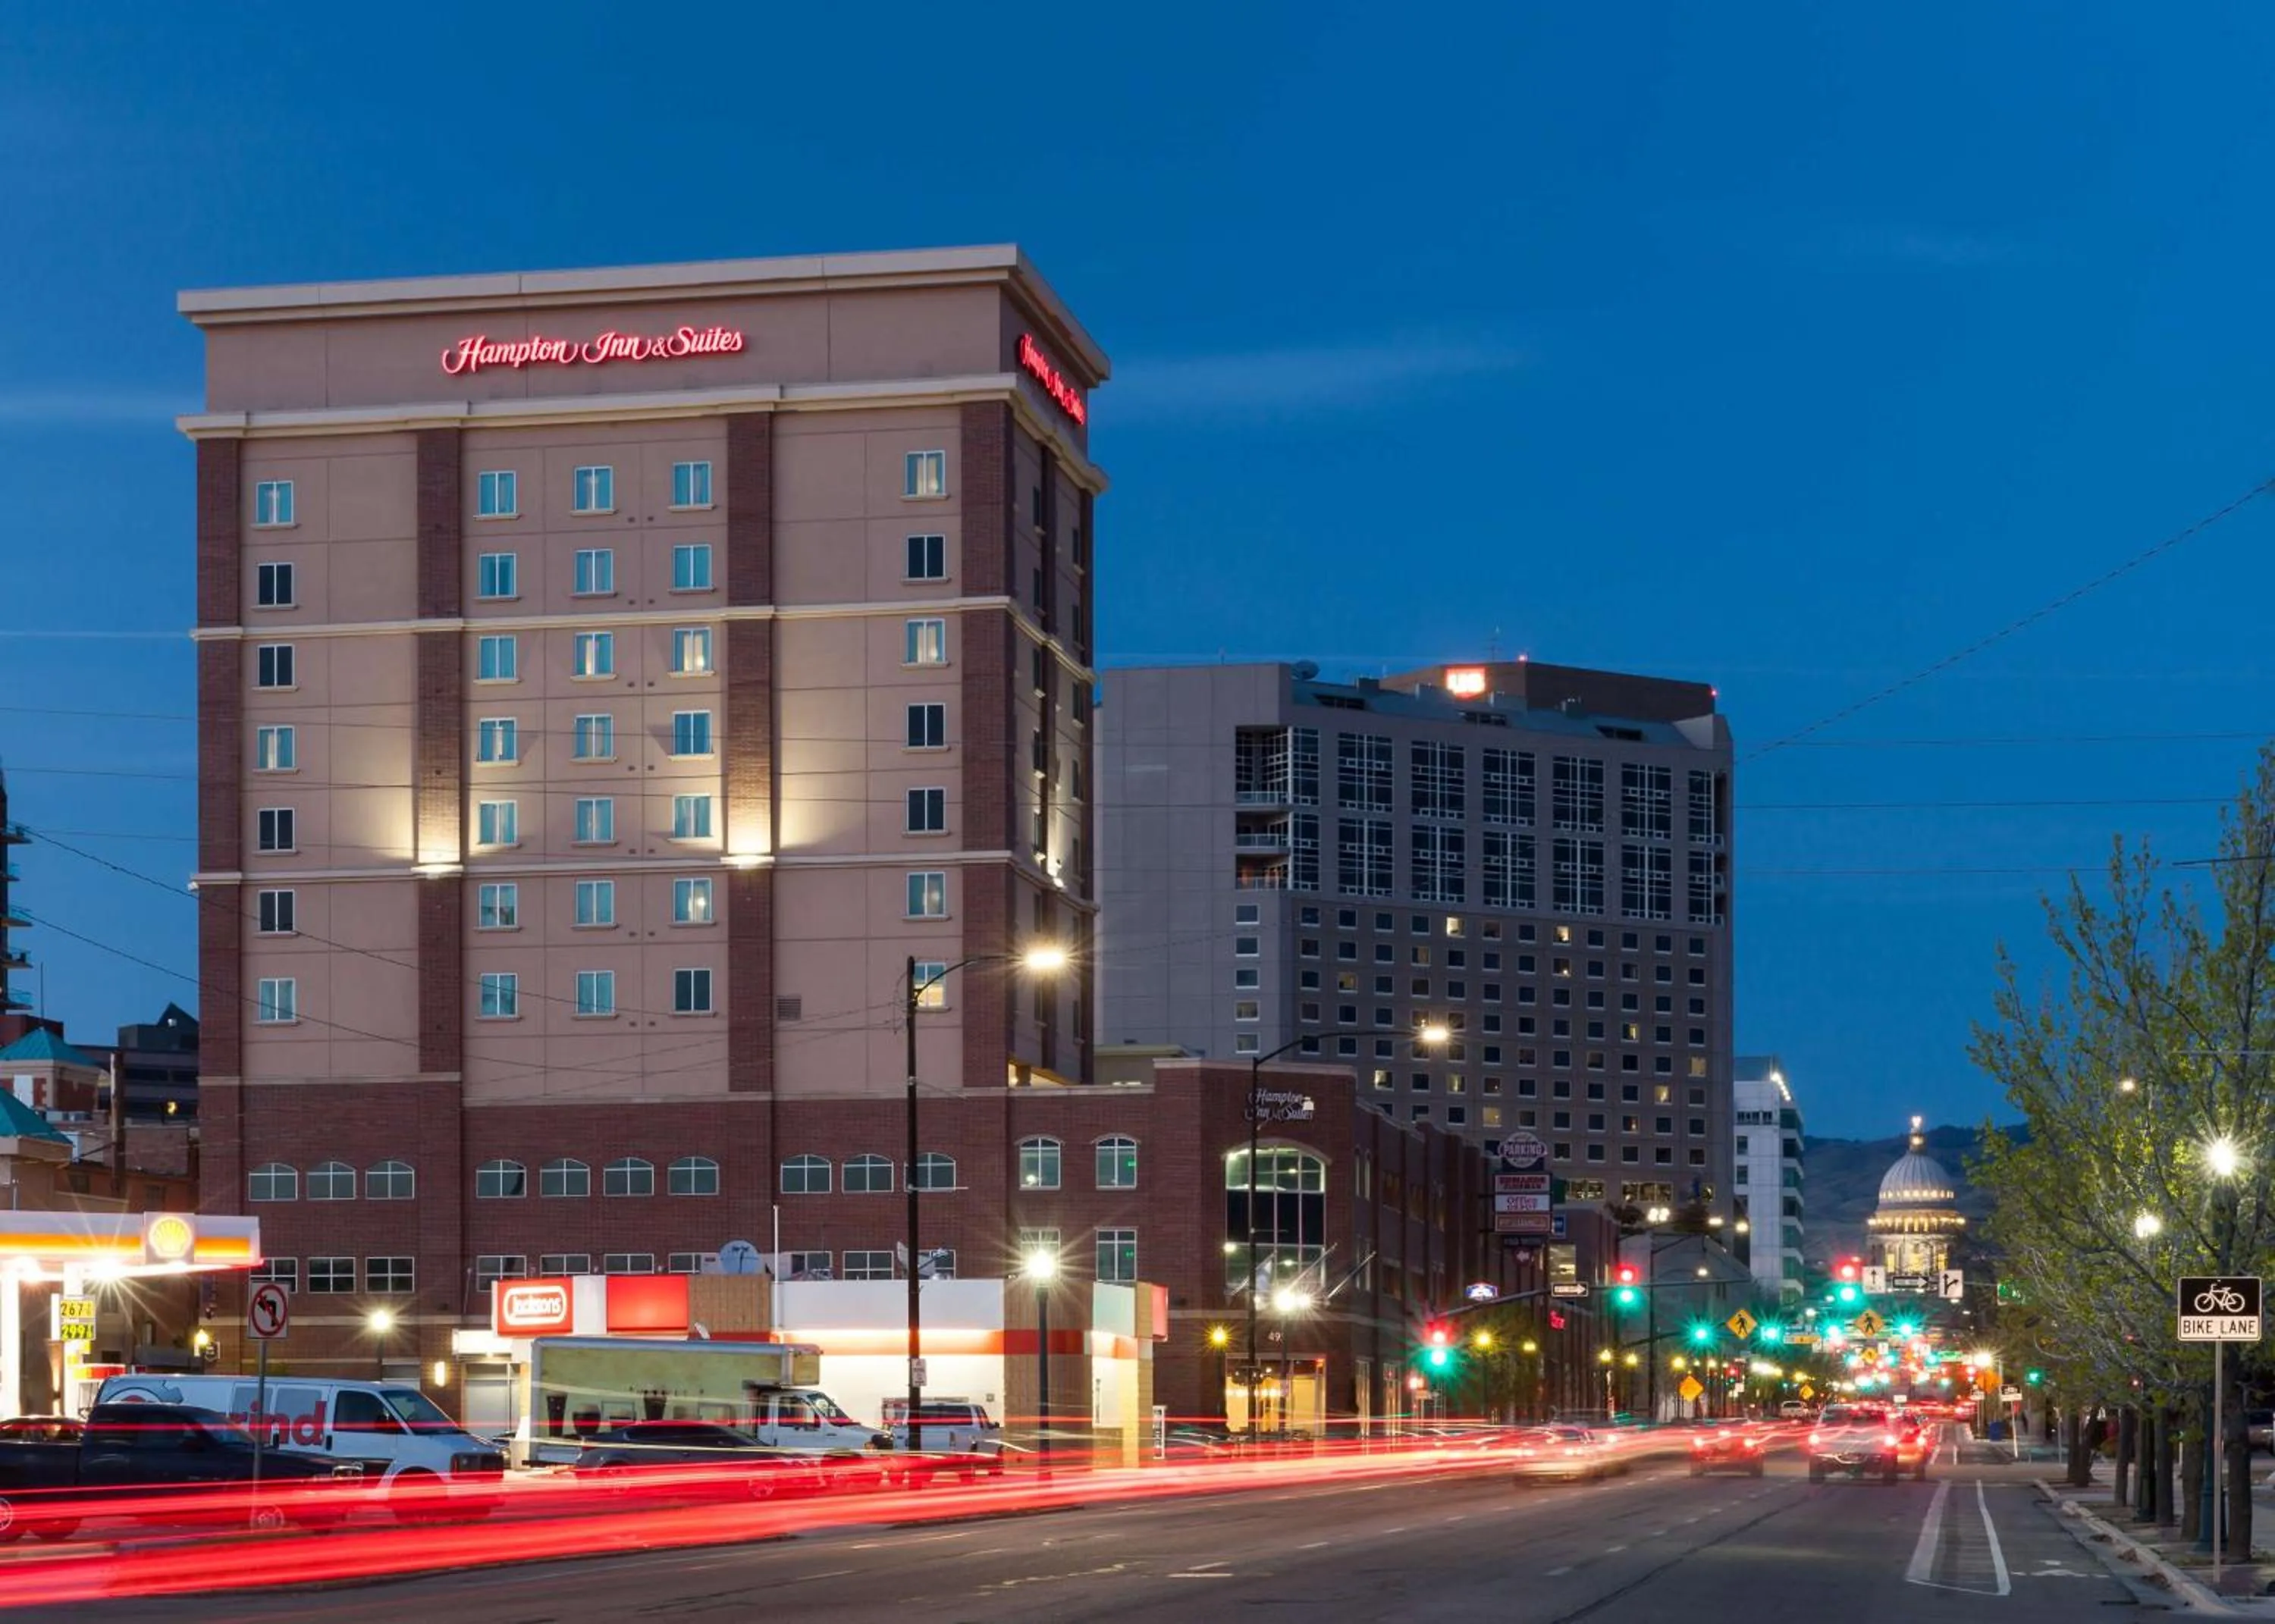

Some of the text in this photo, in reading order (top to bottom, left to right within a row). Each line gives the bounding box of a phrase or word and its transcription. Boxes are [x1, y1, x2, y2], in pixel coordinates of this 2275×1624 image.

[442, 326, 742, 373] Hampton Inn & Suites
[1503, 1143, 1542, 1155] PARKING
[2183, 1320, 2256, 1334] BIKE LANE
